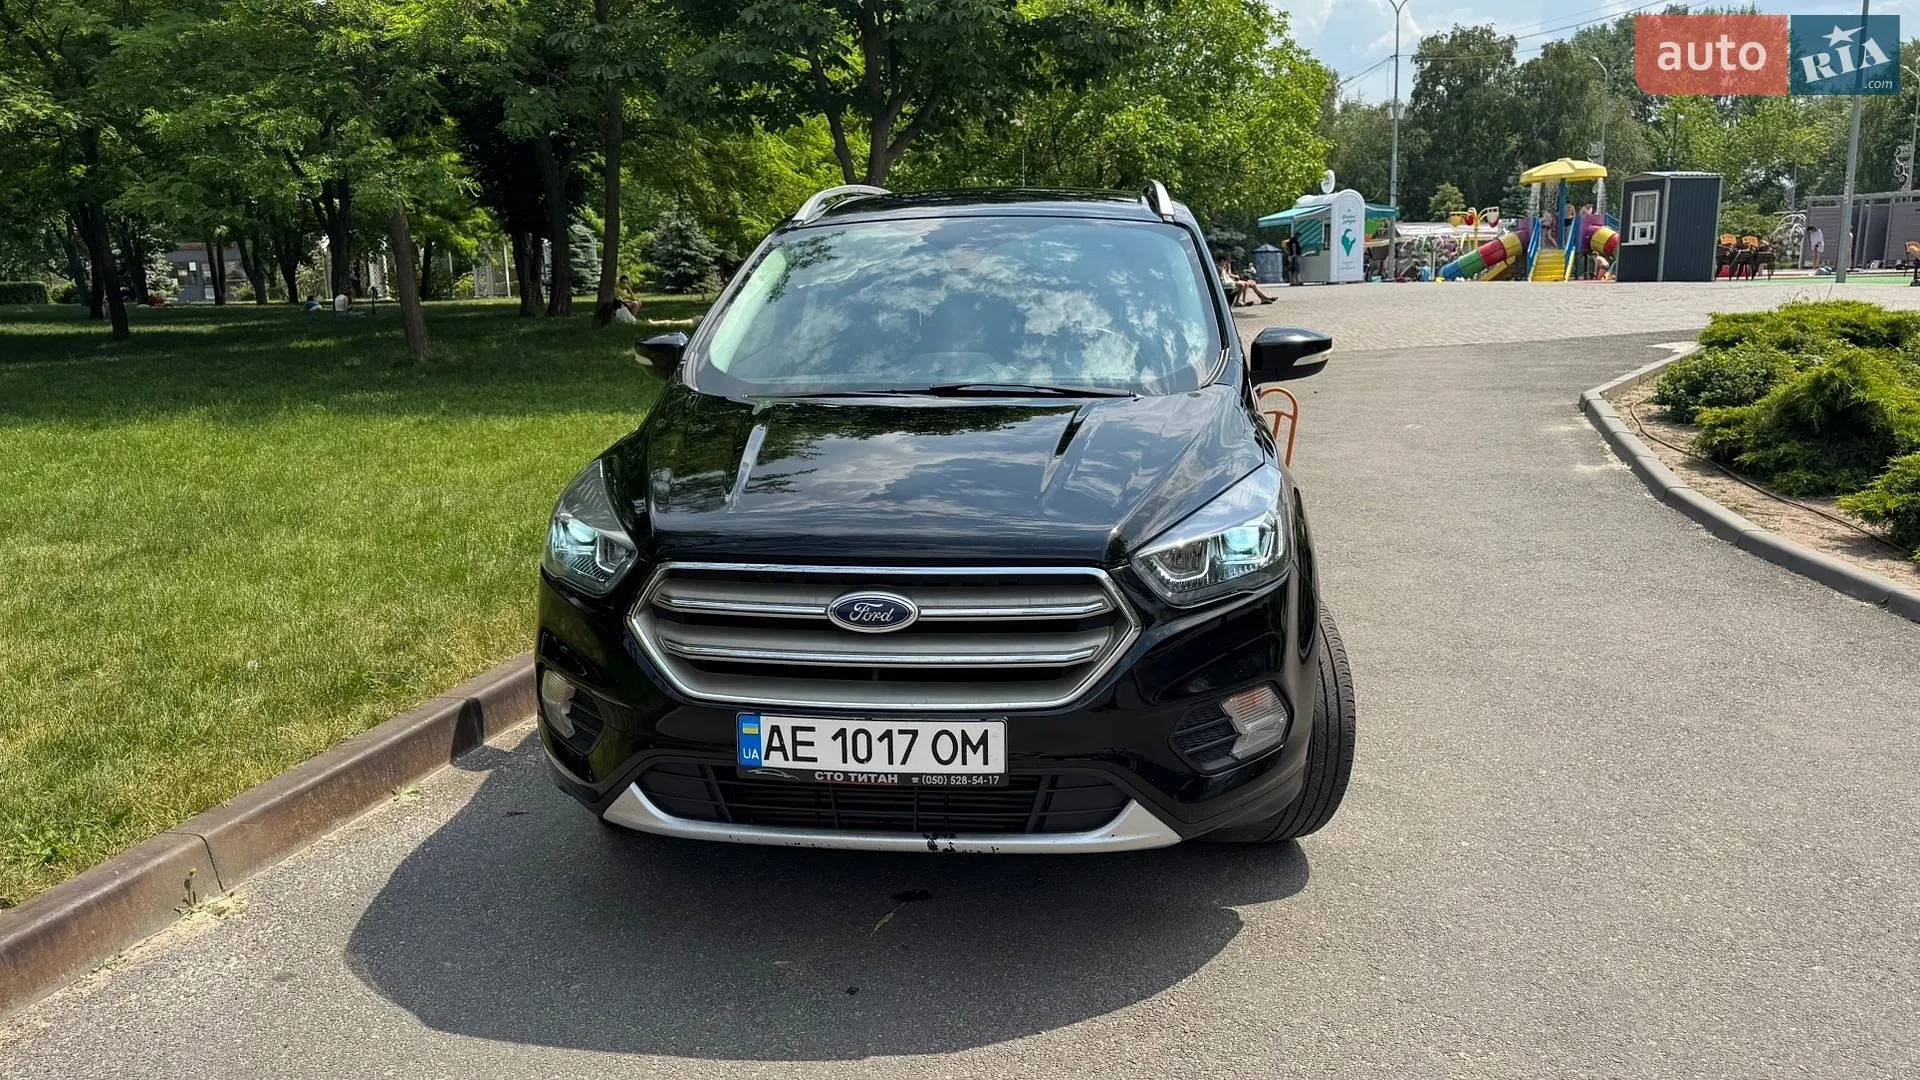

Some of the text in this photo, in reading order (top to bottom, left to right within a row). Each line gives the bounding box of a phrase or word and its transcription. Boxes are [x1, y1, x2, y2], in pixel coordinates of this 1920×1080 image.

[849, 602, 895, 622] Ford
[742, 747, 760, 760] UA
[763, 724, 989, 766] AE 1017 OM
[814, 771, 1000, 786] СТО ТИТАН (050) 528-54-17
